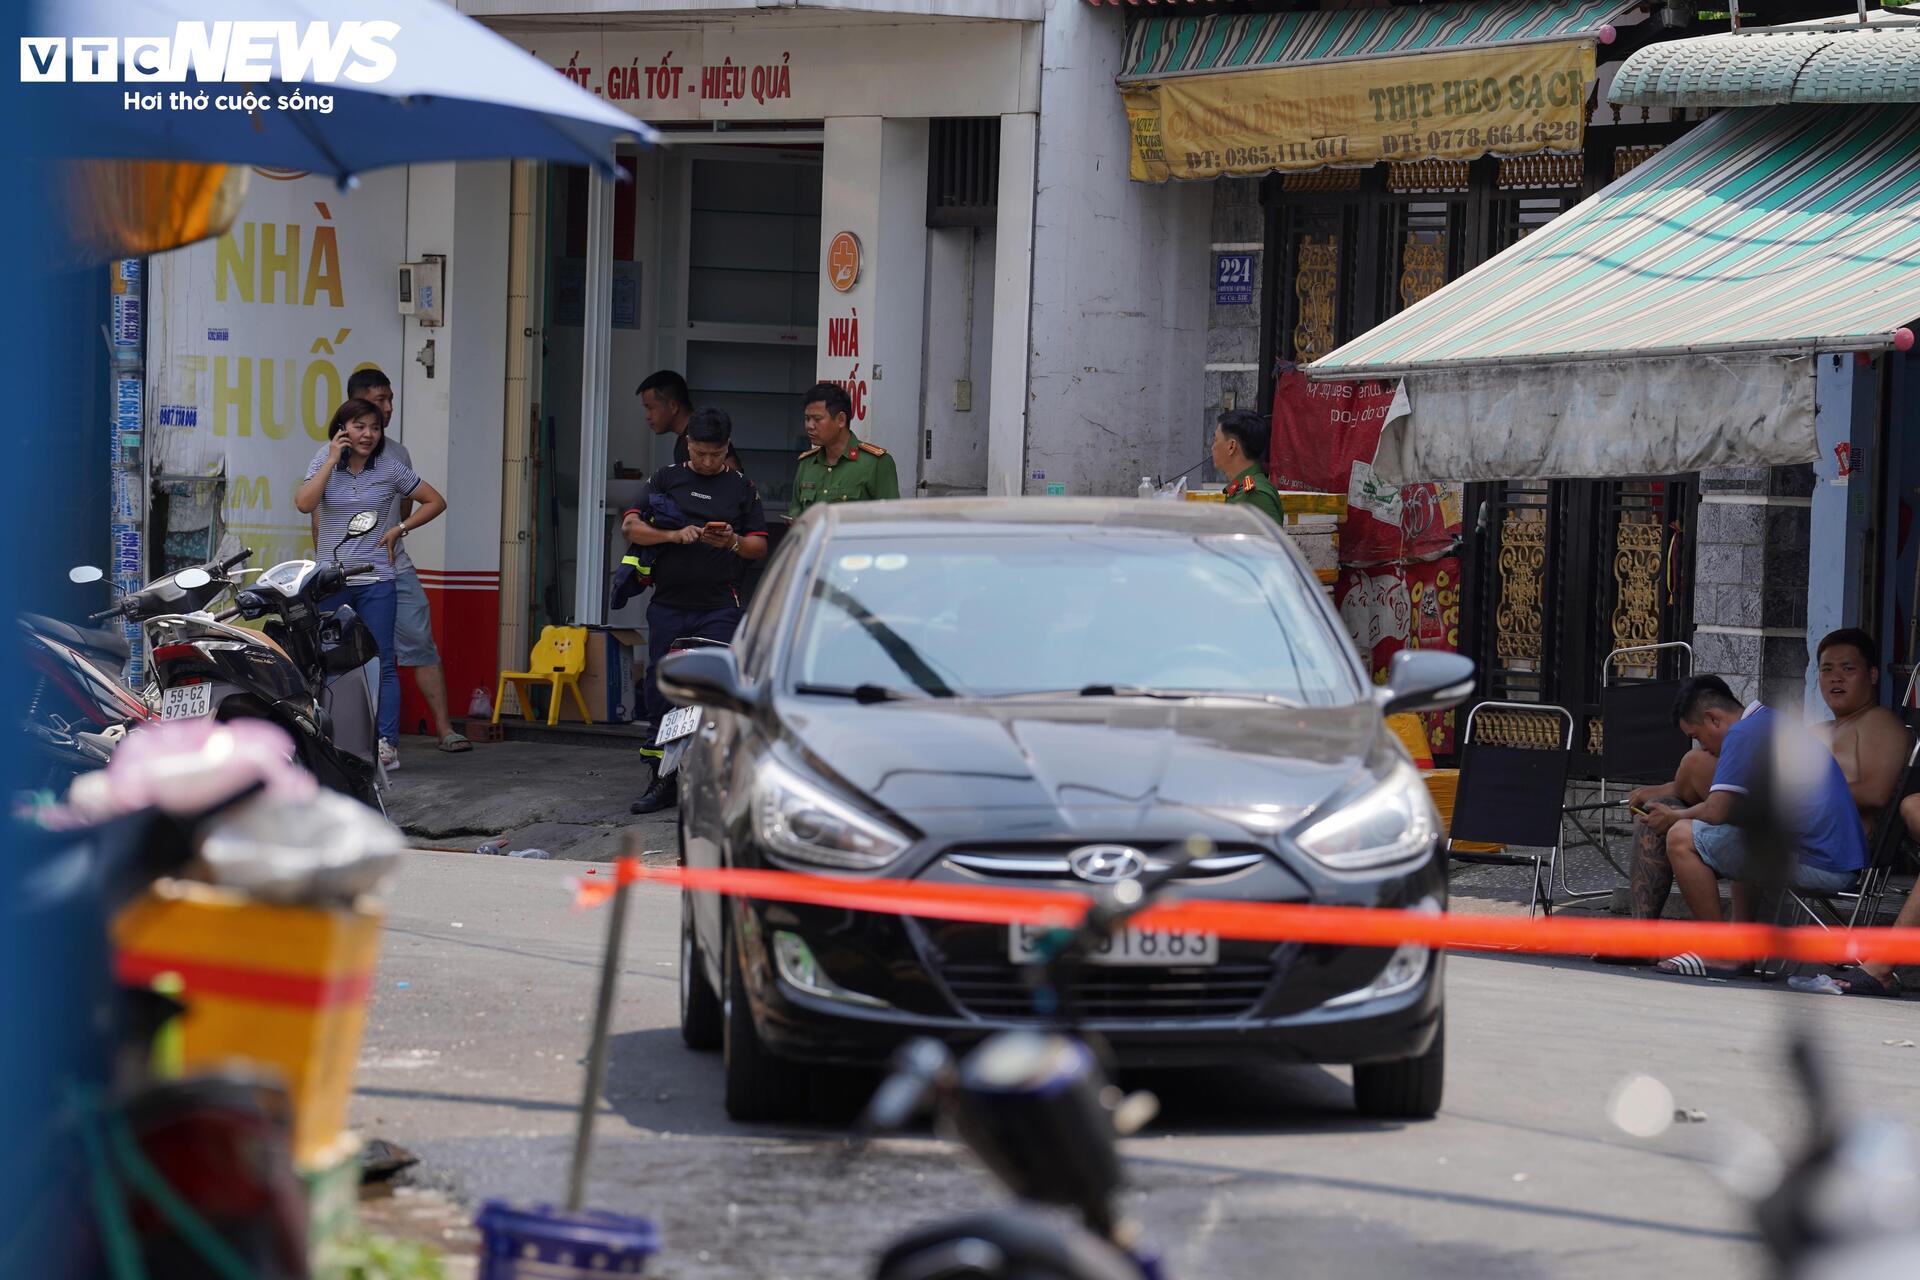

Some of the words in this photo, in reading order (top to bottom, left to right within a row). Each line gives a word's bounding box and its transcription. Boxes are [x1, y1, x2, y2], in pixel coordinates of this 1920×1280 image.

[608, 57, 640, 99] GIÁ
[645, 51, 683, 99] TỐT
[701, 56, 746, 106] HIỆU
[751, 52, 791, 105] QUẢ
[1368, 82, 1435, 129] THỊT
[1442, 77, 1501, 116] HEO
[1427, 121, 1578, 150] 0778.664.628
[214, 202, 344, 308] NHÀ
[1220, 258, 1250, 283] 224
[828, 307, 859, 357] NHÀ
[177, 328, 384, 442] THUỐ
[165, 700, 205, 719] 979.48
[170, 686, 204, 704] 59-G2
